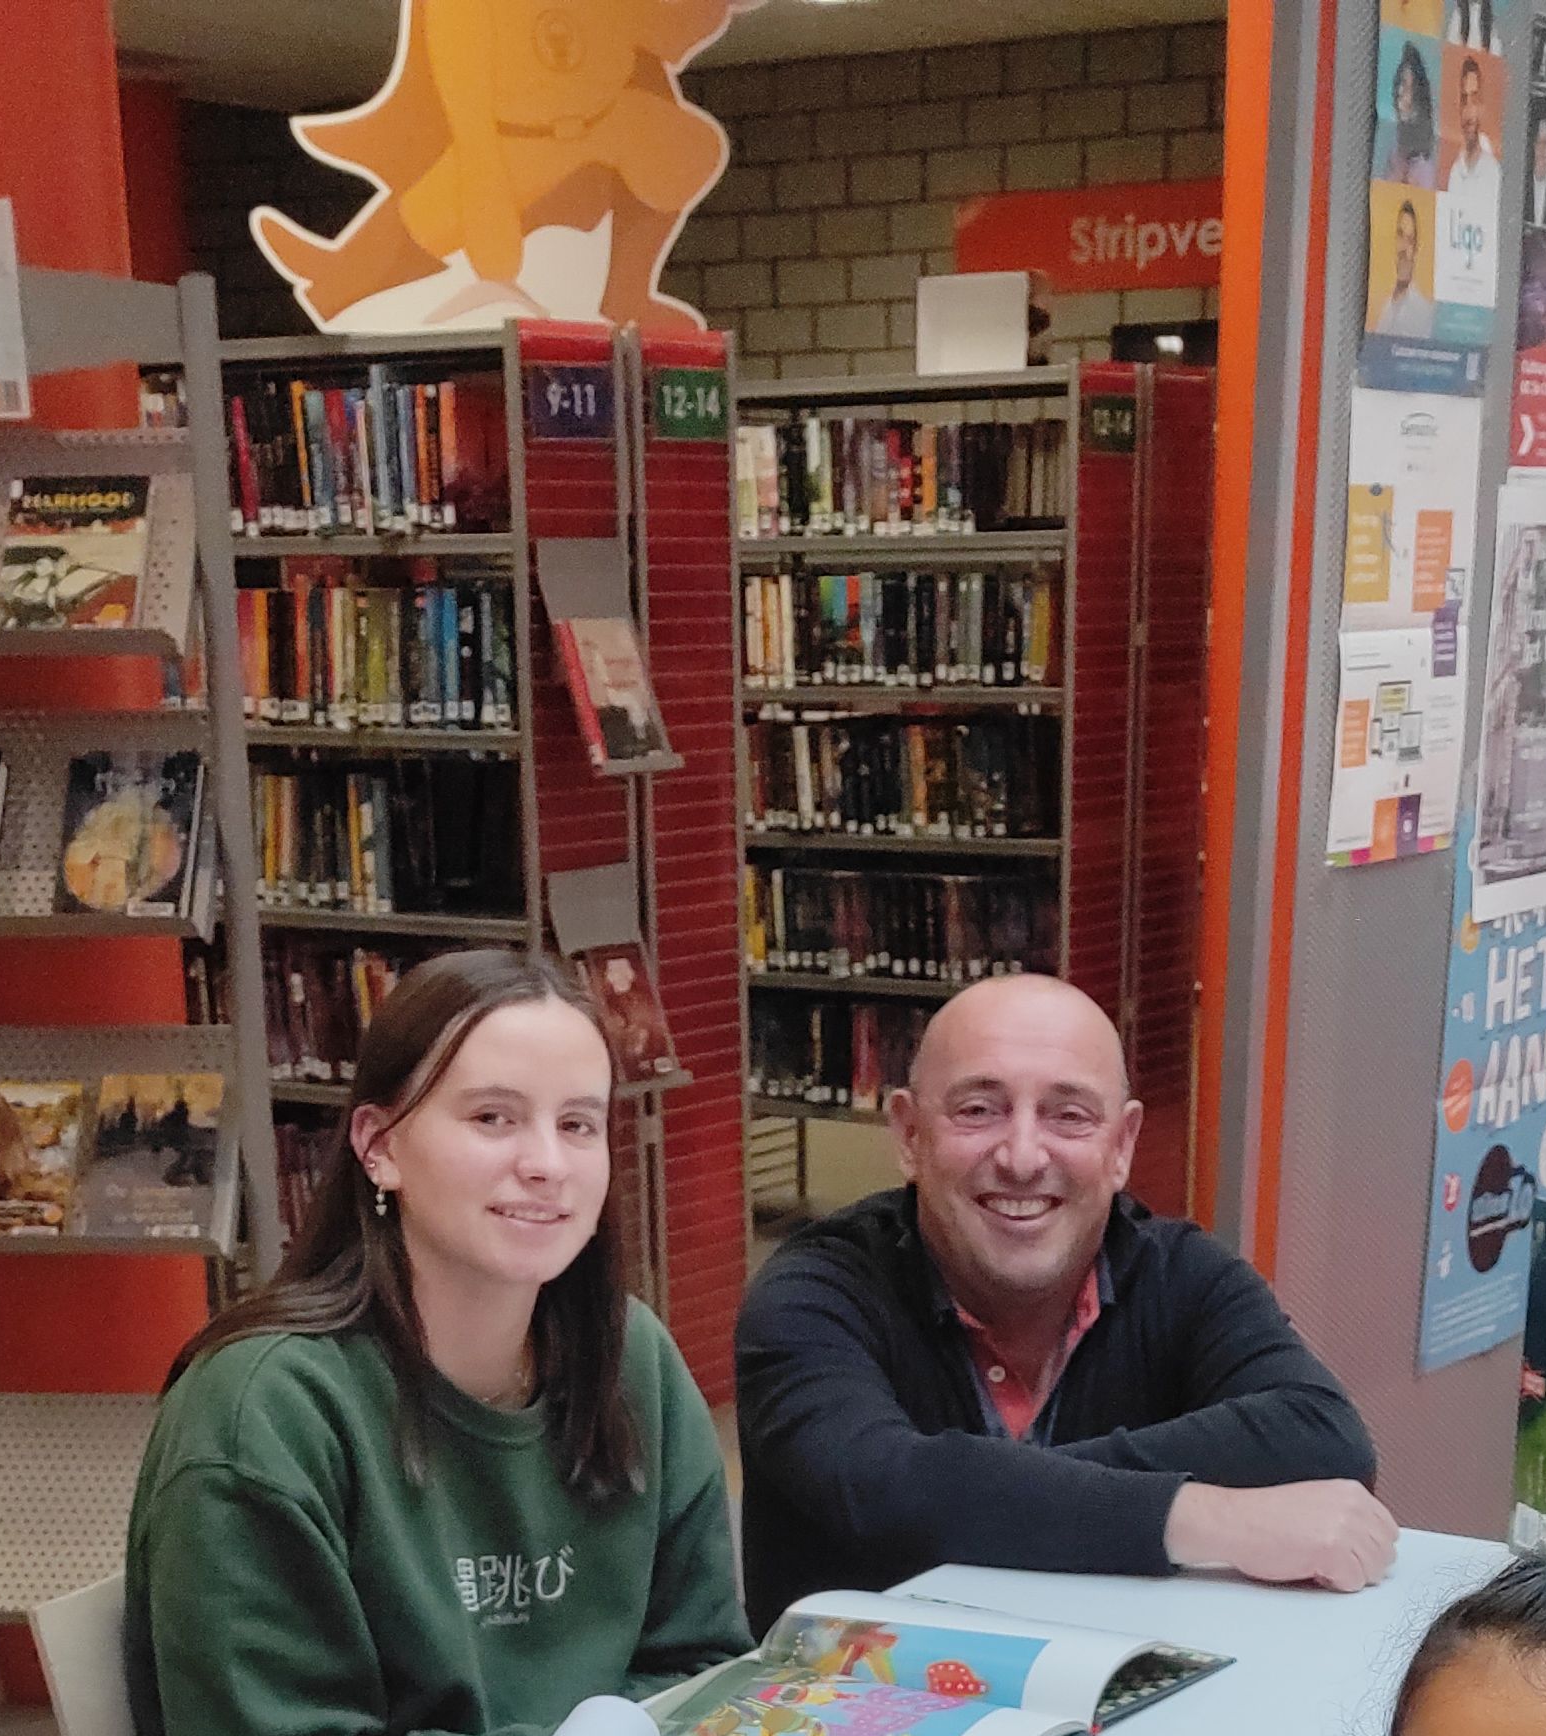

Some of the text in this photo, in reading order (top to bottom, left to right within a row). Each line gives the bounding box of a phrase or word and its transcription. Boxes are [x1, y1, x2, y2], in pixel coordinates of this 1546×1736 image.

[1069, 214, 1223, 268] Stripve
[545, 382, 597, 418] 9-11
[660, 382, 723, 421] 12-14
